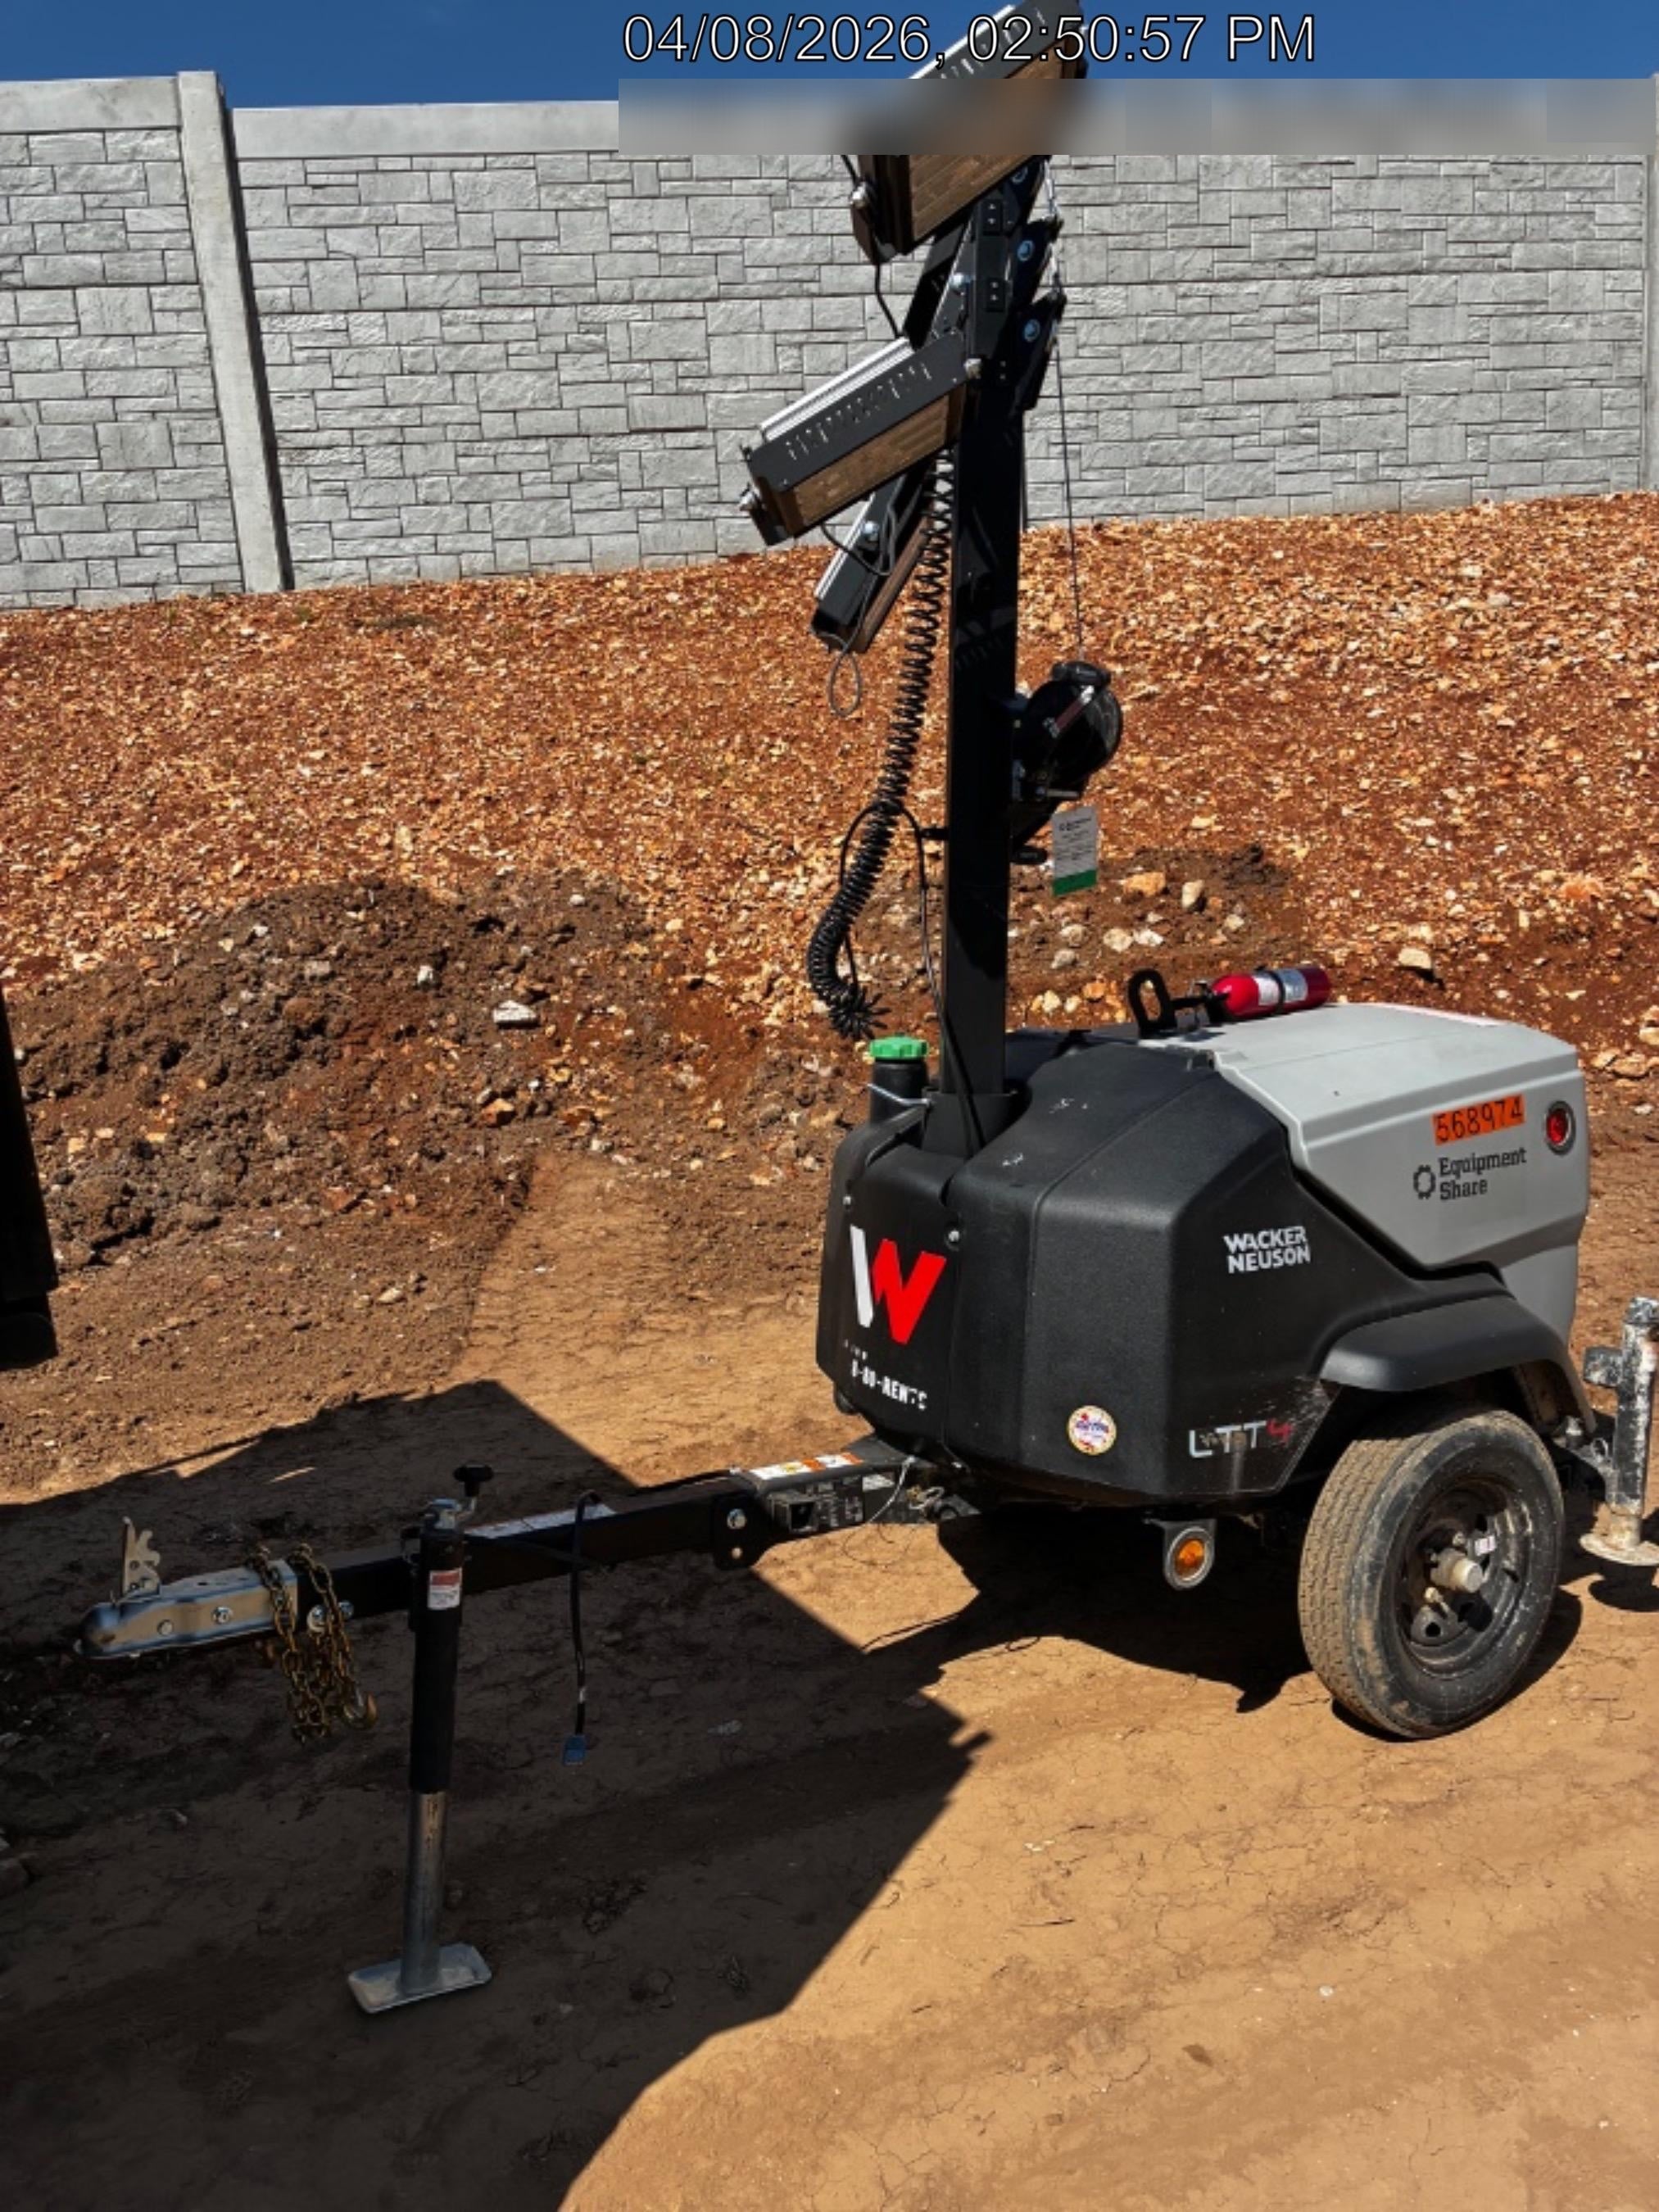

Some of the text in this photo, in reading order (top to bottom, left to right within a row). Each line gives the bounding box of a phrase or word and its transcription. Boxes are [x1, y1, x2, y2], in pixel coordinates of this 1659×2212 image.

[1435, 1095, 1522, 1142] 568974
[1438, 1147, 1527, 1179] Equipment
[1439, 1179, 1488, 1200] Share
[1222, 1225, 1308, 1253] WACKER
[1227, 1243, 1311, 1273] NEUSON
